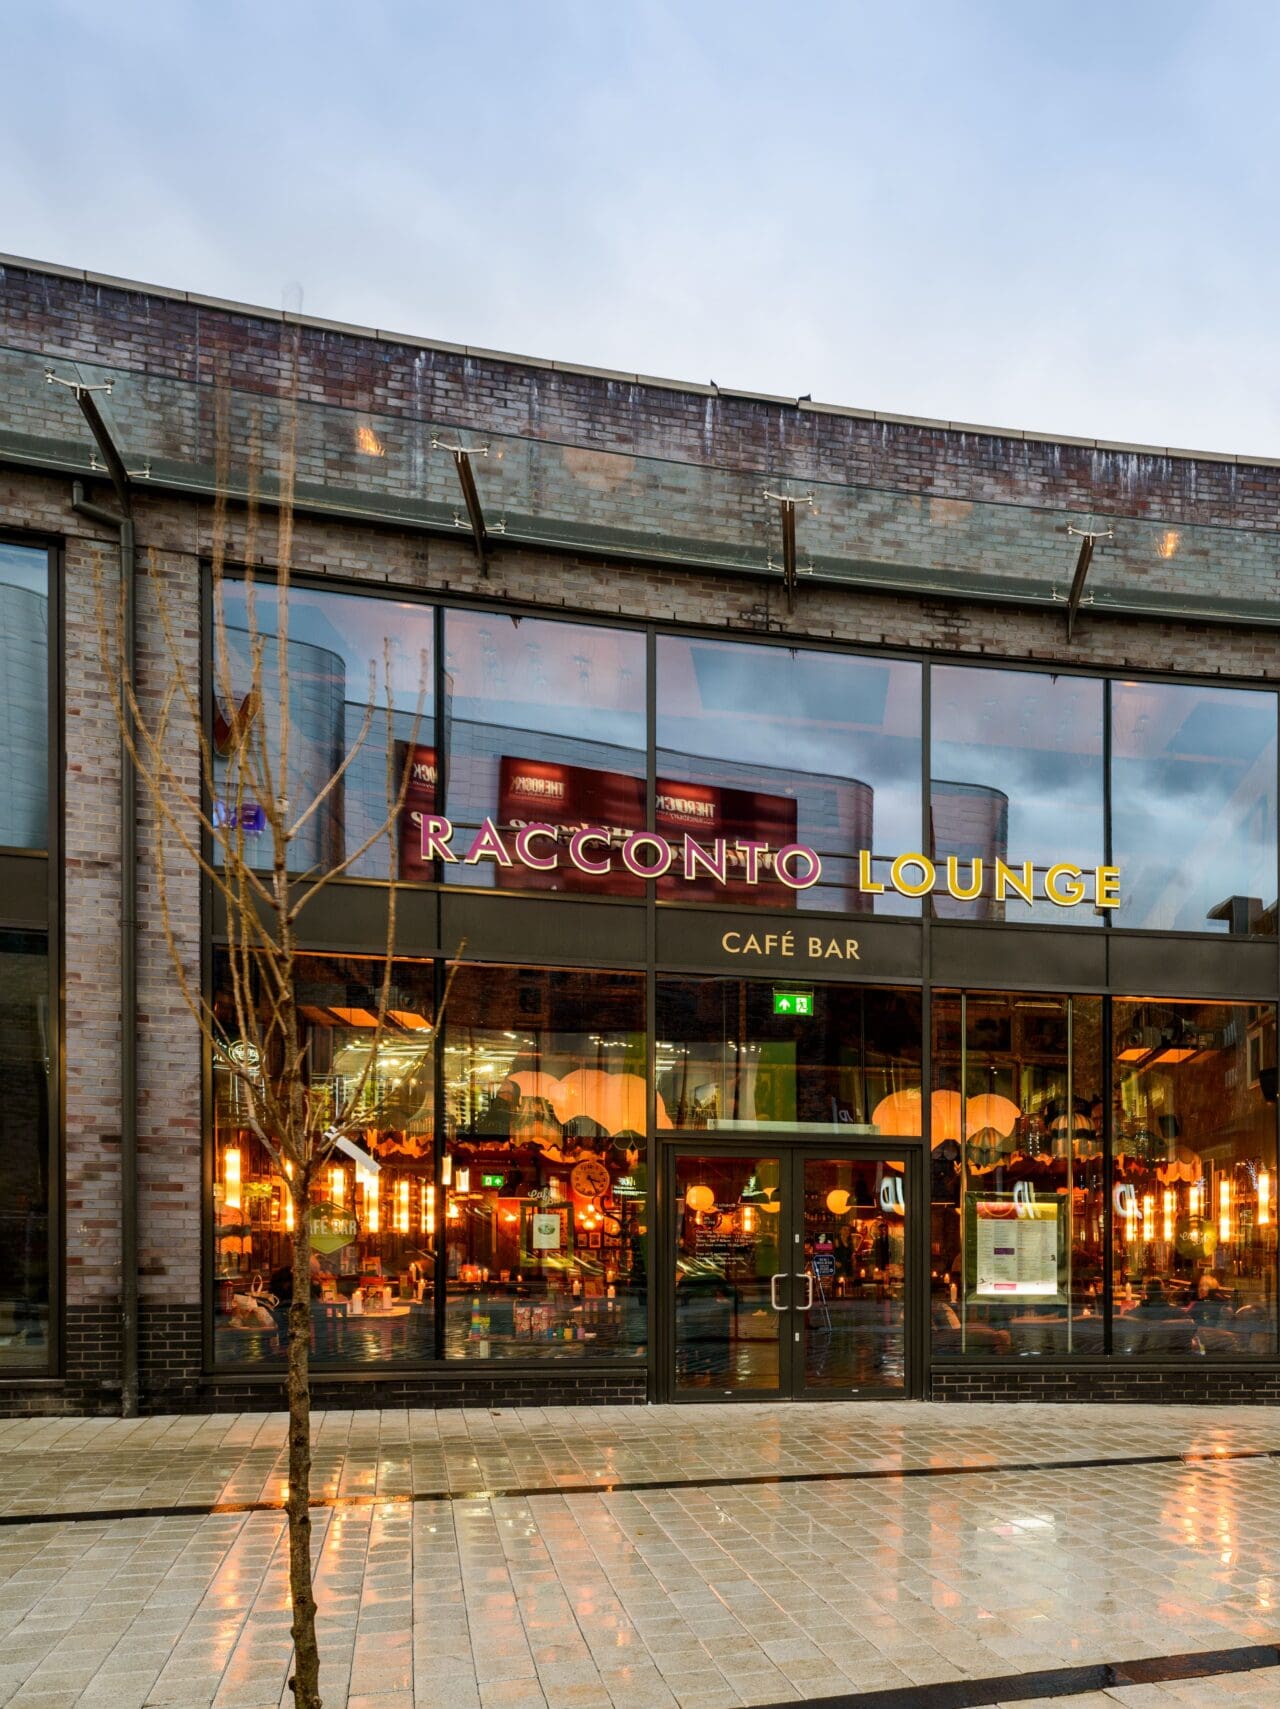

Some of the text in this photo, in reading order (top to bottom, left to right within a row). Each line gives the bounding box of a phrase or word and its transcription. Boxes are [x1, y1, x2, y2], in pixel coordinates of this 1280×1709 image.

[420, 813, 1121, 909] RACCONTO LOUNGE
[722, 931, 861, 961] CAFÉ BAR
[331, 1218, 357, 1235] BAR
